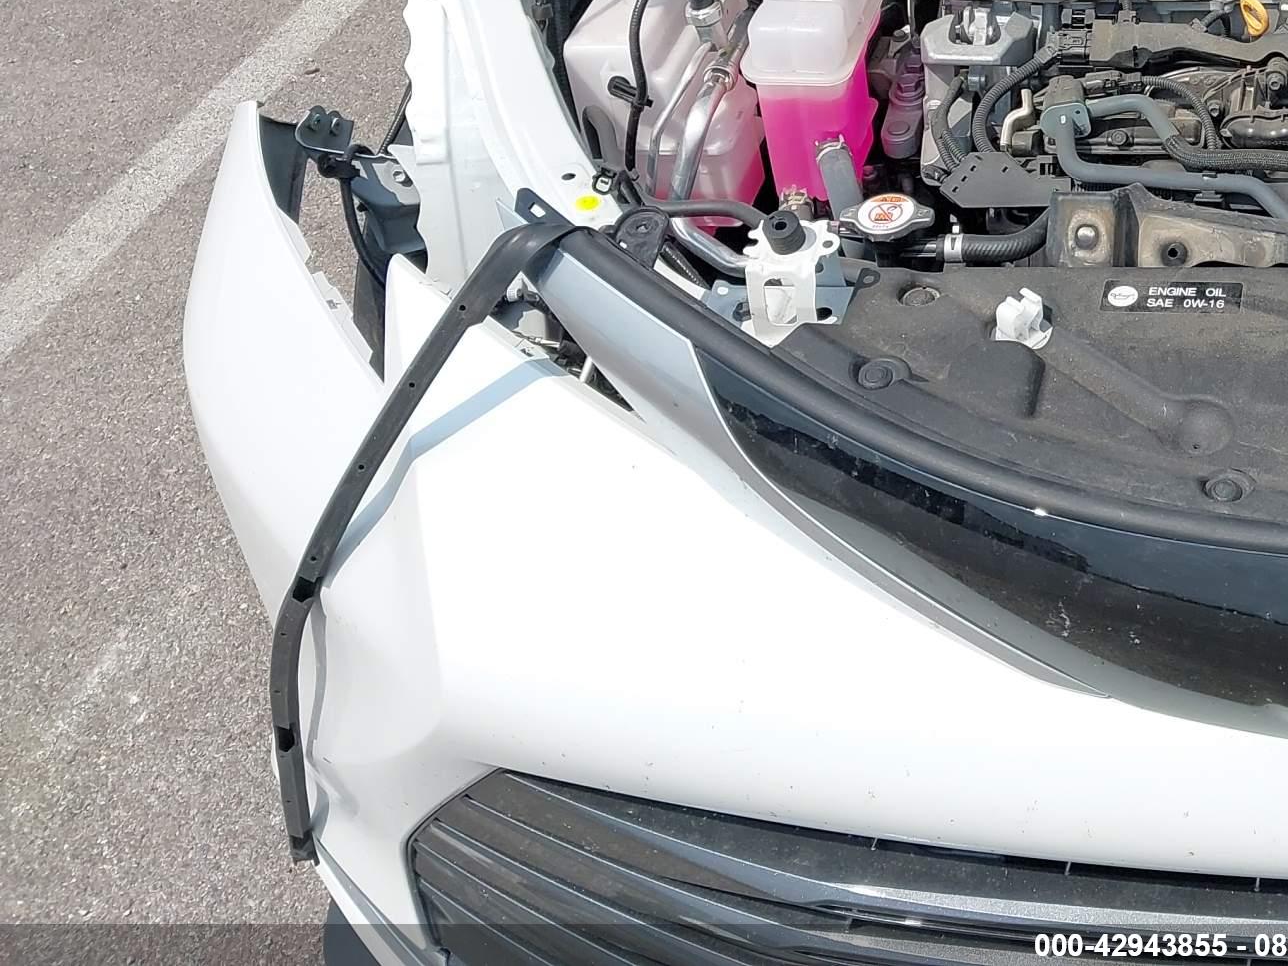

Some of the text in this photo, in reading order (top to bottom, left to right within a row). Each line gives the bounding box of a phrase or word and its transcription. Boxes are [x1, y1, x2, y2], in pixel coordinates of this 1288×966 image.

[1148, 286, 1197, 297] ENGINE
[1205, 287, 1227, 298] OIL
[1146, 298, 1225, 309] SAE 0W-16
